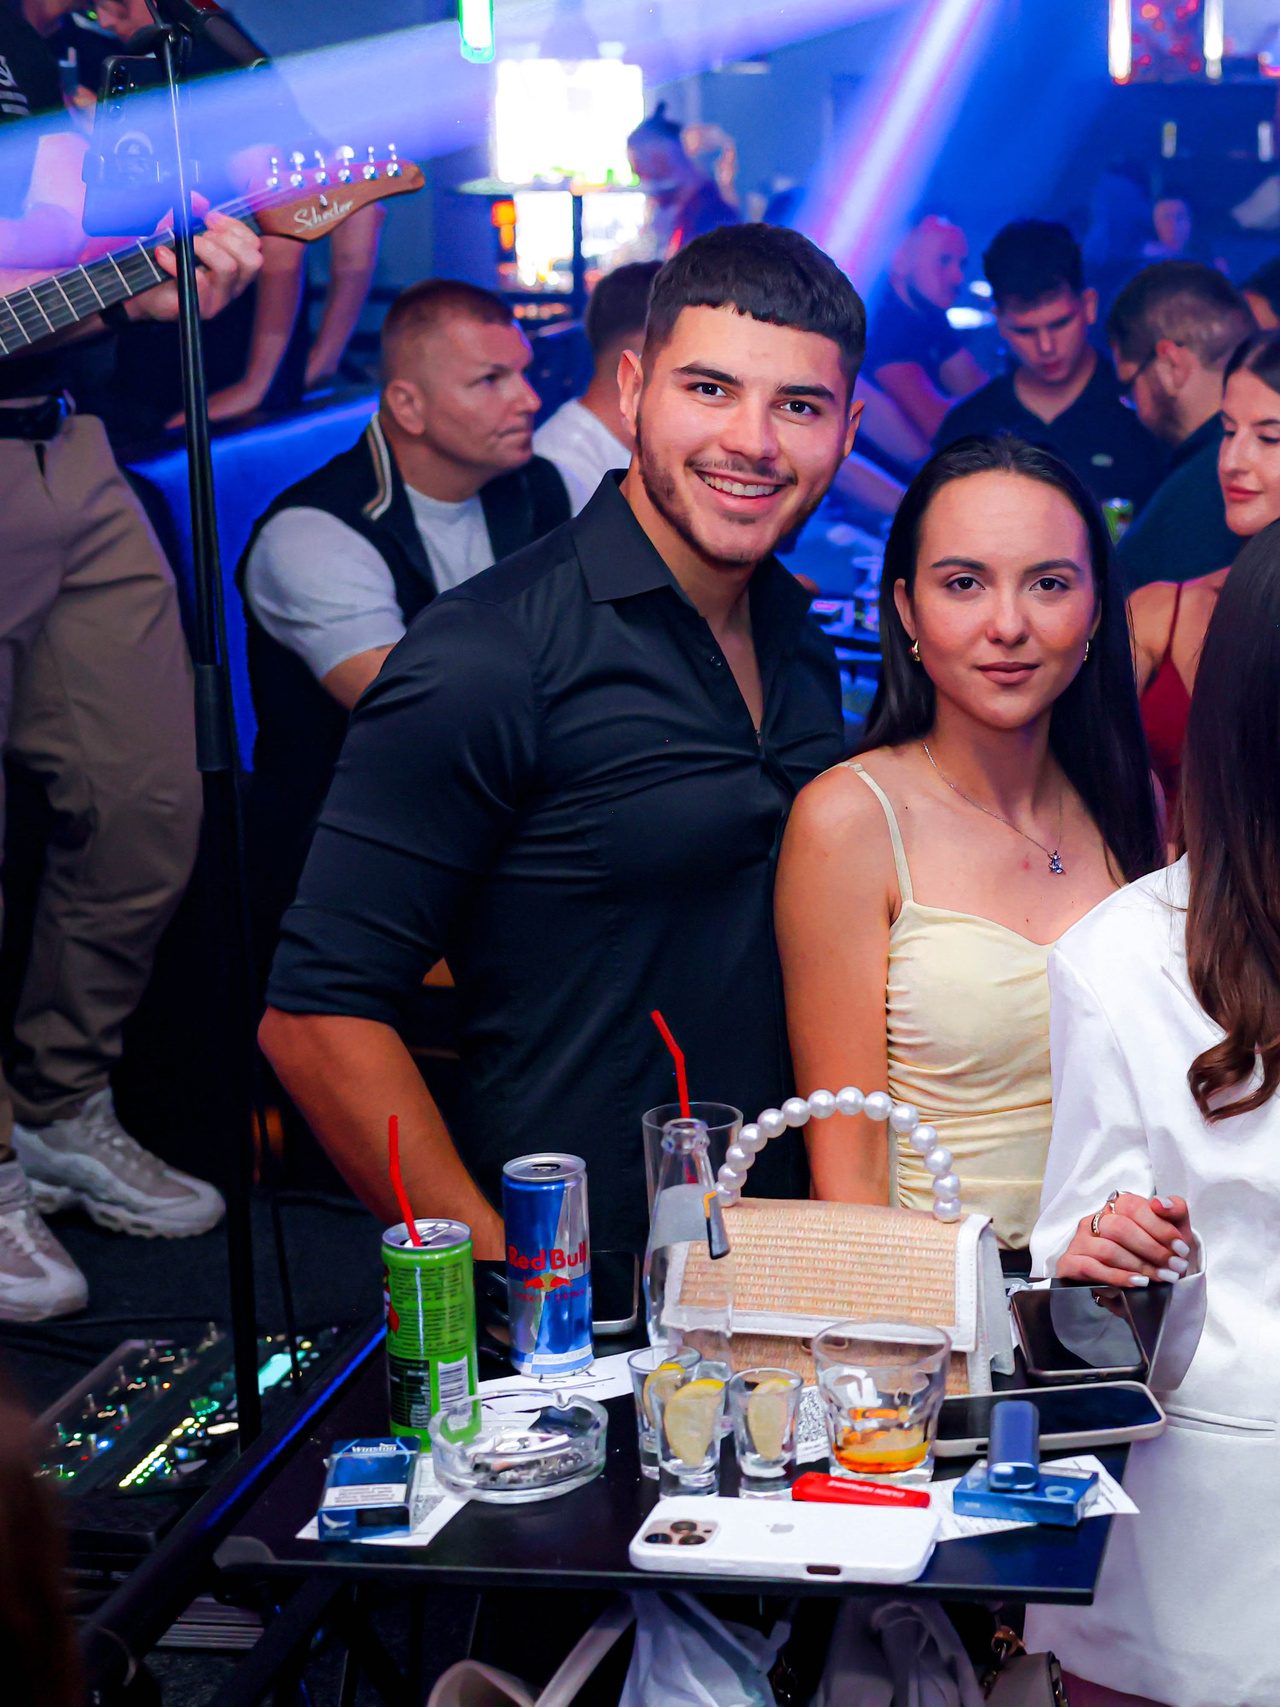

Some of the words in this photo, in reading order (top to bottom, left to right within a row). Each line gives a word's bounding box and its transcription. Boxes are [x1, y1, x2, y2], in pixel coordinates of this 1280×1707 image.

[508, 1244, 546, 1271] Red
[550, 1239, 587, 1271] Bull
[351, 1442, 398, 1453] Winston
